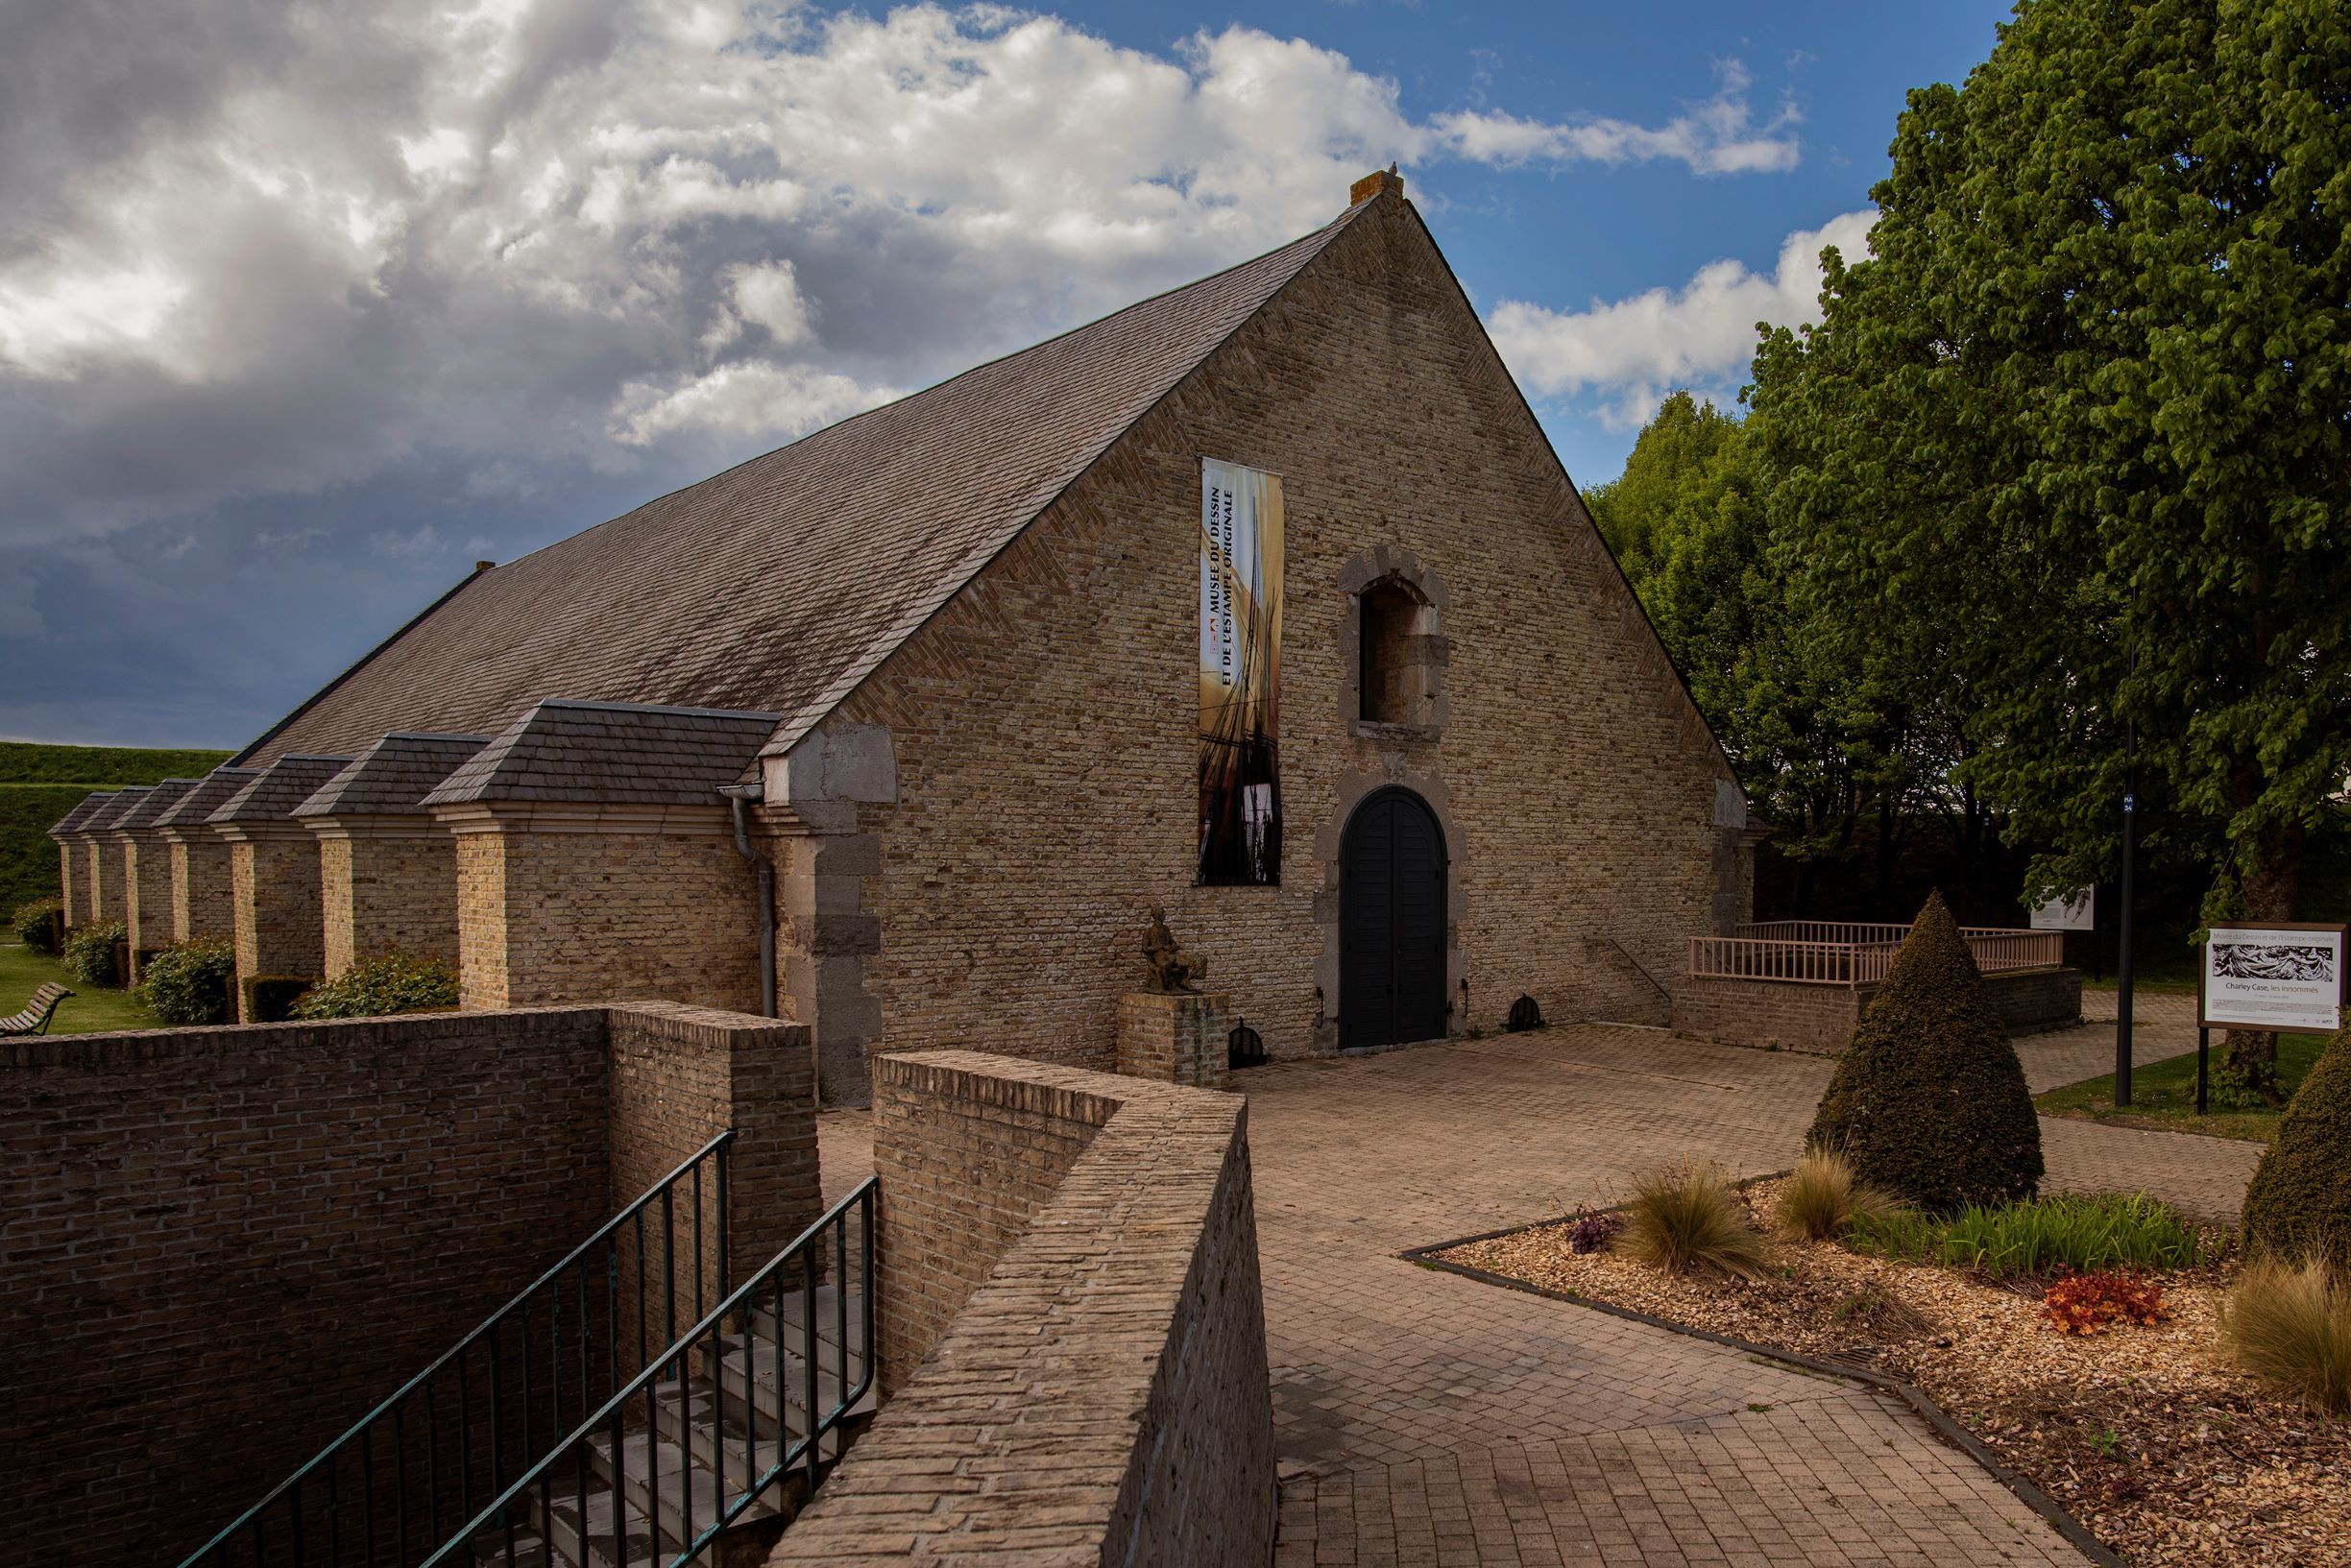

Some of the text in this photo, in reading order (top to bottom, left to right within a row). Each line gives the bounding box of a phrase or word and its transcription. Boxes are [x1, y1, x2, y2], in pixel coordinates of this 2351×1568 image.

[1210, 487, 1220, 614] MUSEE DU DESSIN
[1222, 490, 1233, 686] ET DE L'ESTAMPE ORIGINALE
[2226, 981, 2251, 992] Charley
[2251, 983, 2269, 992] Case,
